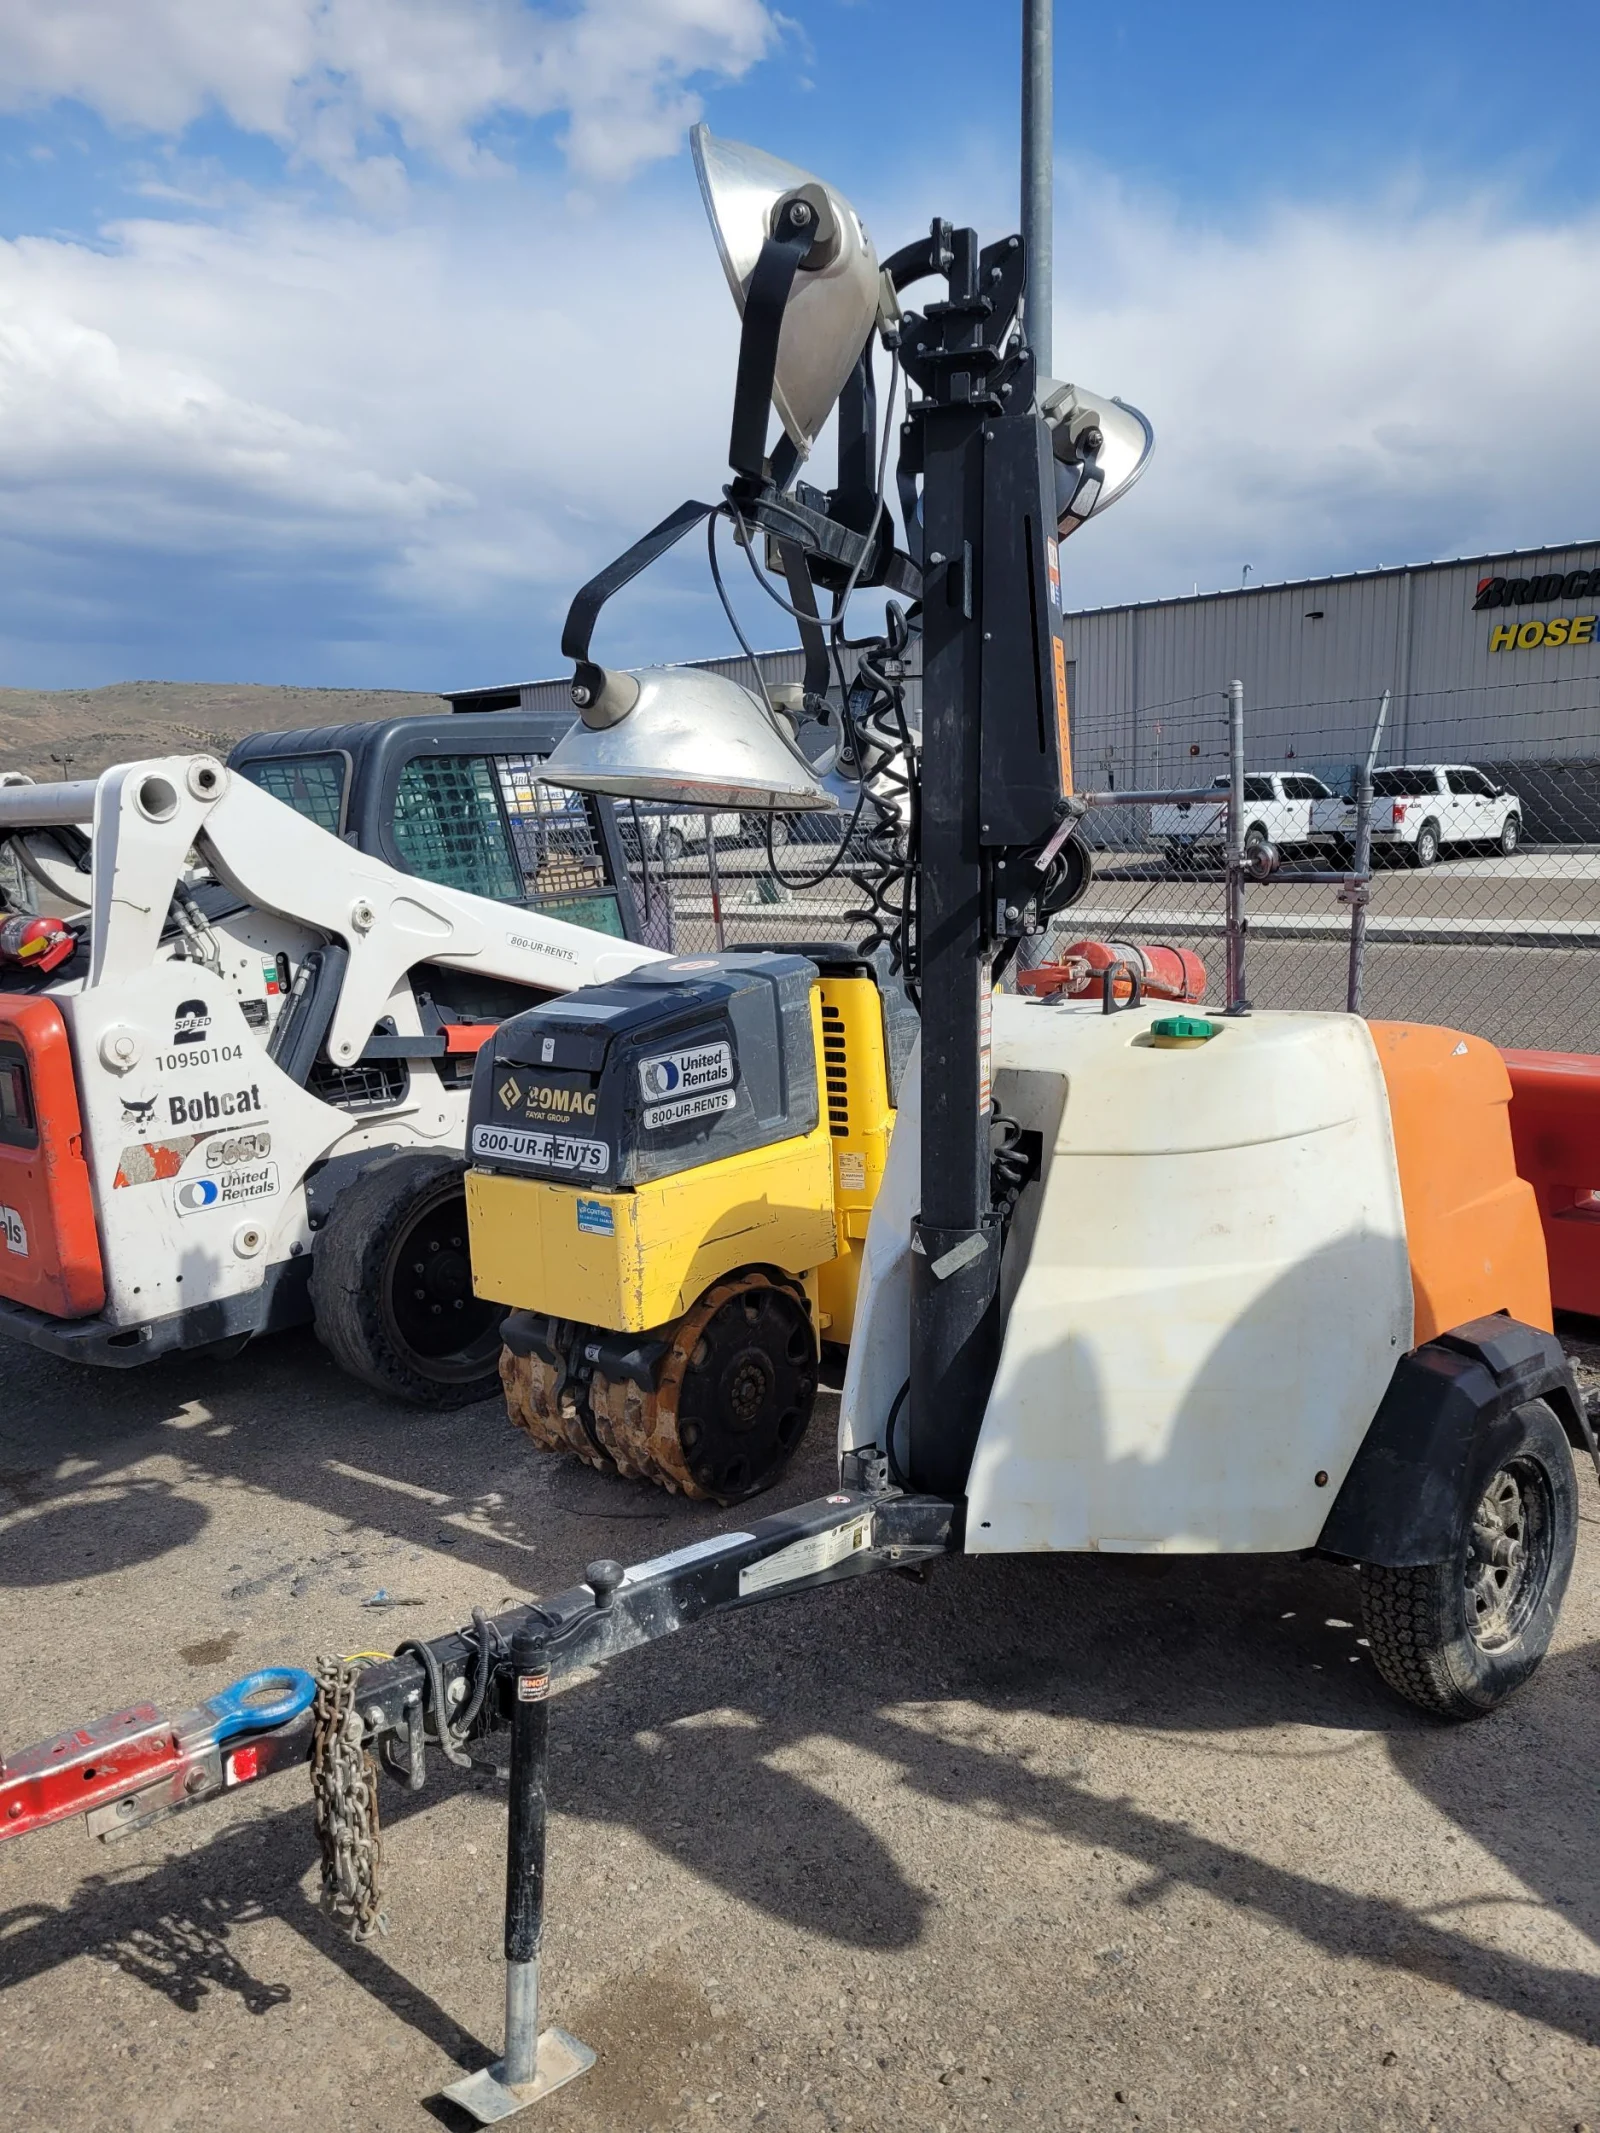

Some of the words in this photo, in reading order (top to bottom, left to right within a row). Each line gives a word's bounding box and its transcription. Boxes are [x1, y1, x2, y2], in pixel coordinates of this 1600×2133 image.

[1489, 615, 1598, 653] HOSE
[510, 936, 574, 961] 800-UR-RENTS
[174, 1016, 212, 1031] SPEED
[155, 1044, 243, 1072] 10950104
[681, 1049, 722, 1072] United
[682, 1065, 728, 1088] Rentals
[168, 1083, 262, 1126] Bobcat
[526, 1086, 597, 1116] BOMAG
[651, 1094, 728, 1124] 800-UR-RENTS
[525, 1110, 546, 1120] FAYAT
[546, 1112, 571, 1123] GROUP
[478, 1132, 602, 1166] 800-UR-RENTS
[220, 1167, 269, 1188] United
[221, 1180, 275, 1201] Rentals
